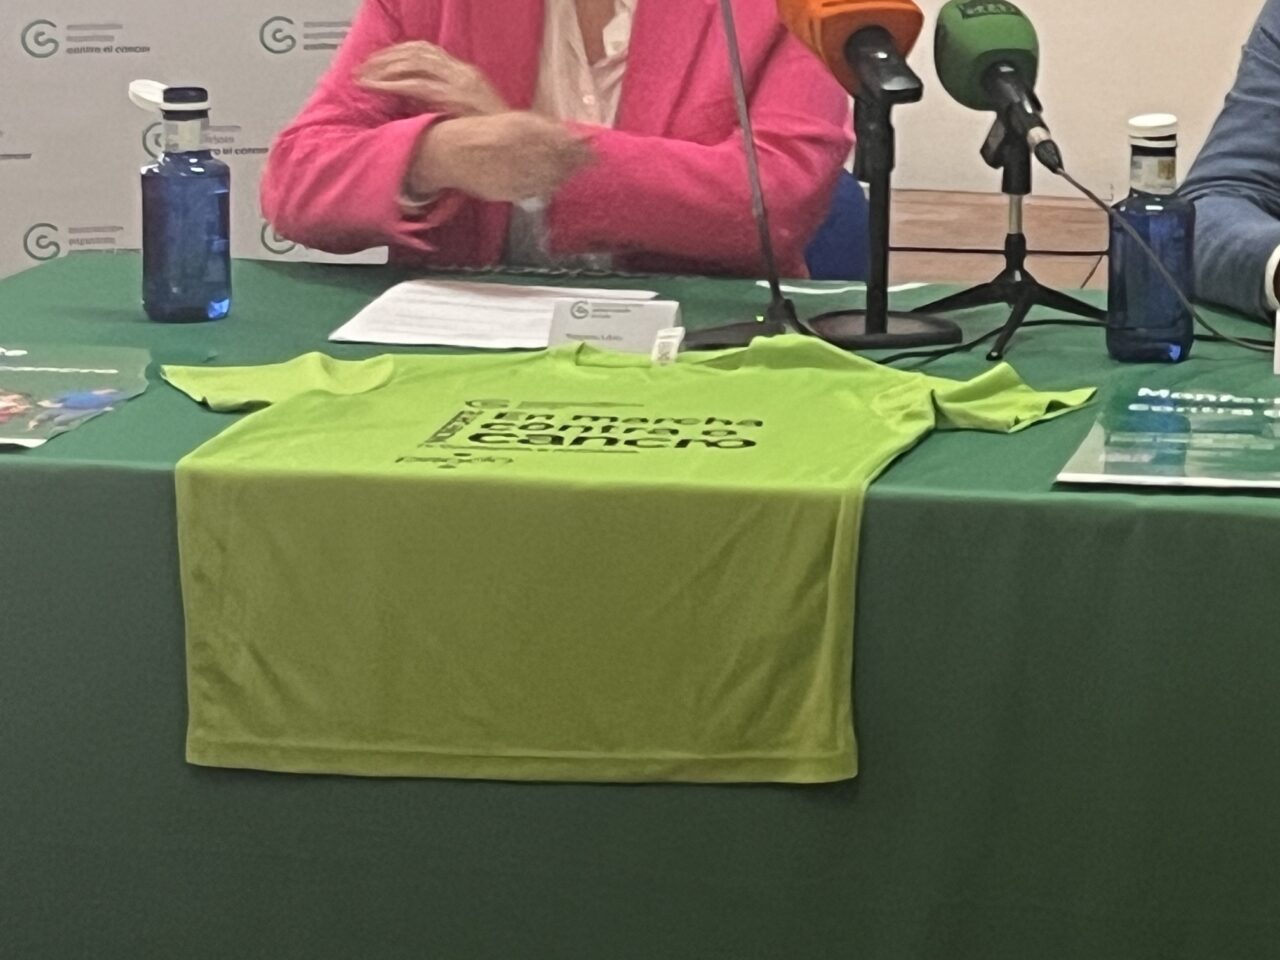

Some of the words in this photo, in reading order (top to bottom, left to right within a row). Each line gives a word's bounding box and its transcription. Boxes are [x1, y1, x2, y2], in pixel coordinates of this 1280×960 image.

[493, 411, 555, 421] En
[571, 414, 763, 427] marcha
[480, 421, 680, 436] contra
[701, 428, 738, 437] o
[467, 432, 757, 449] cancro
